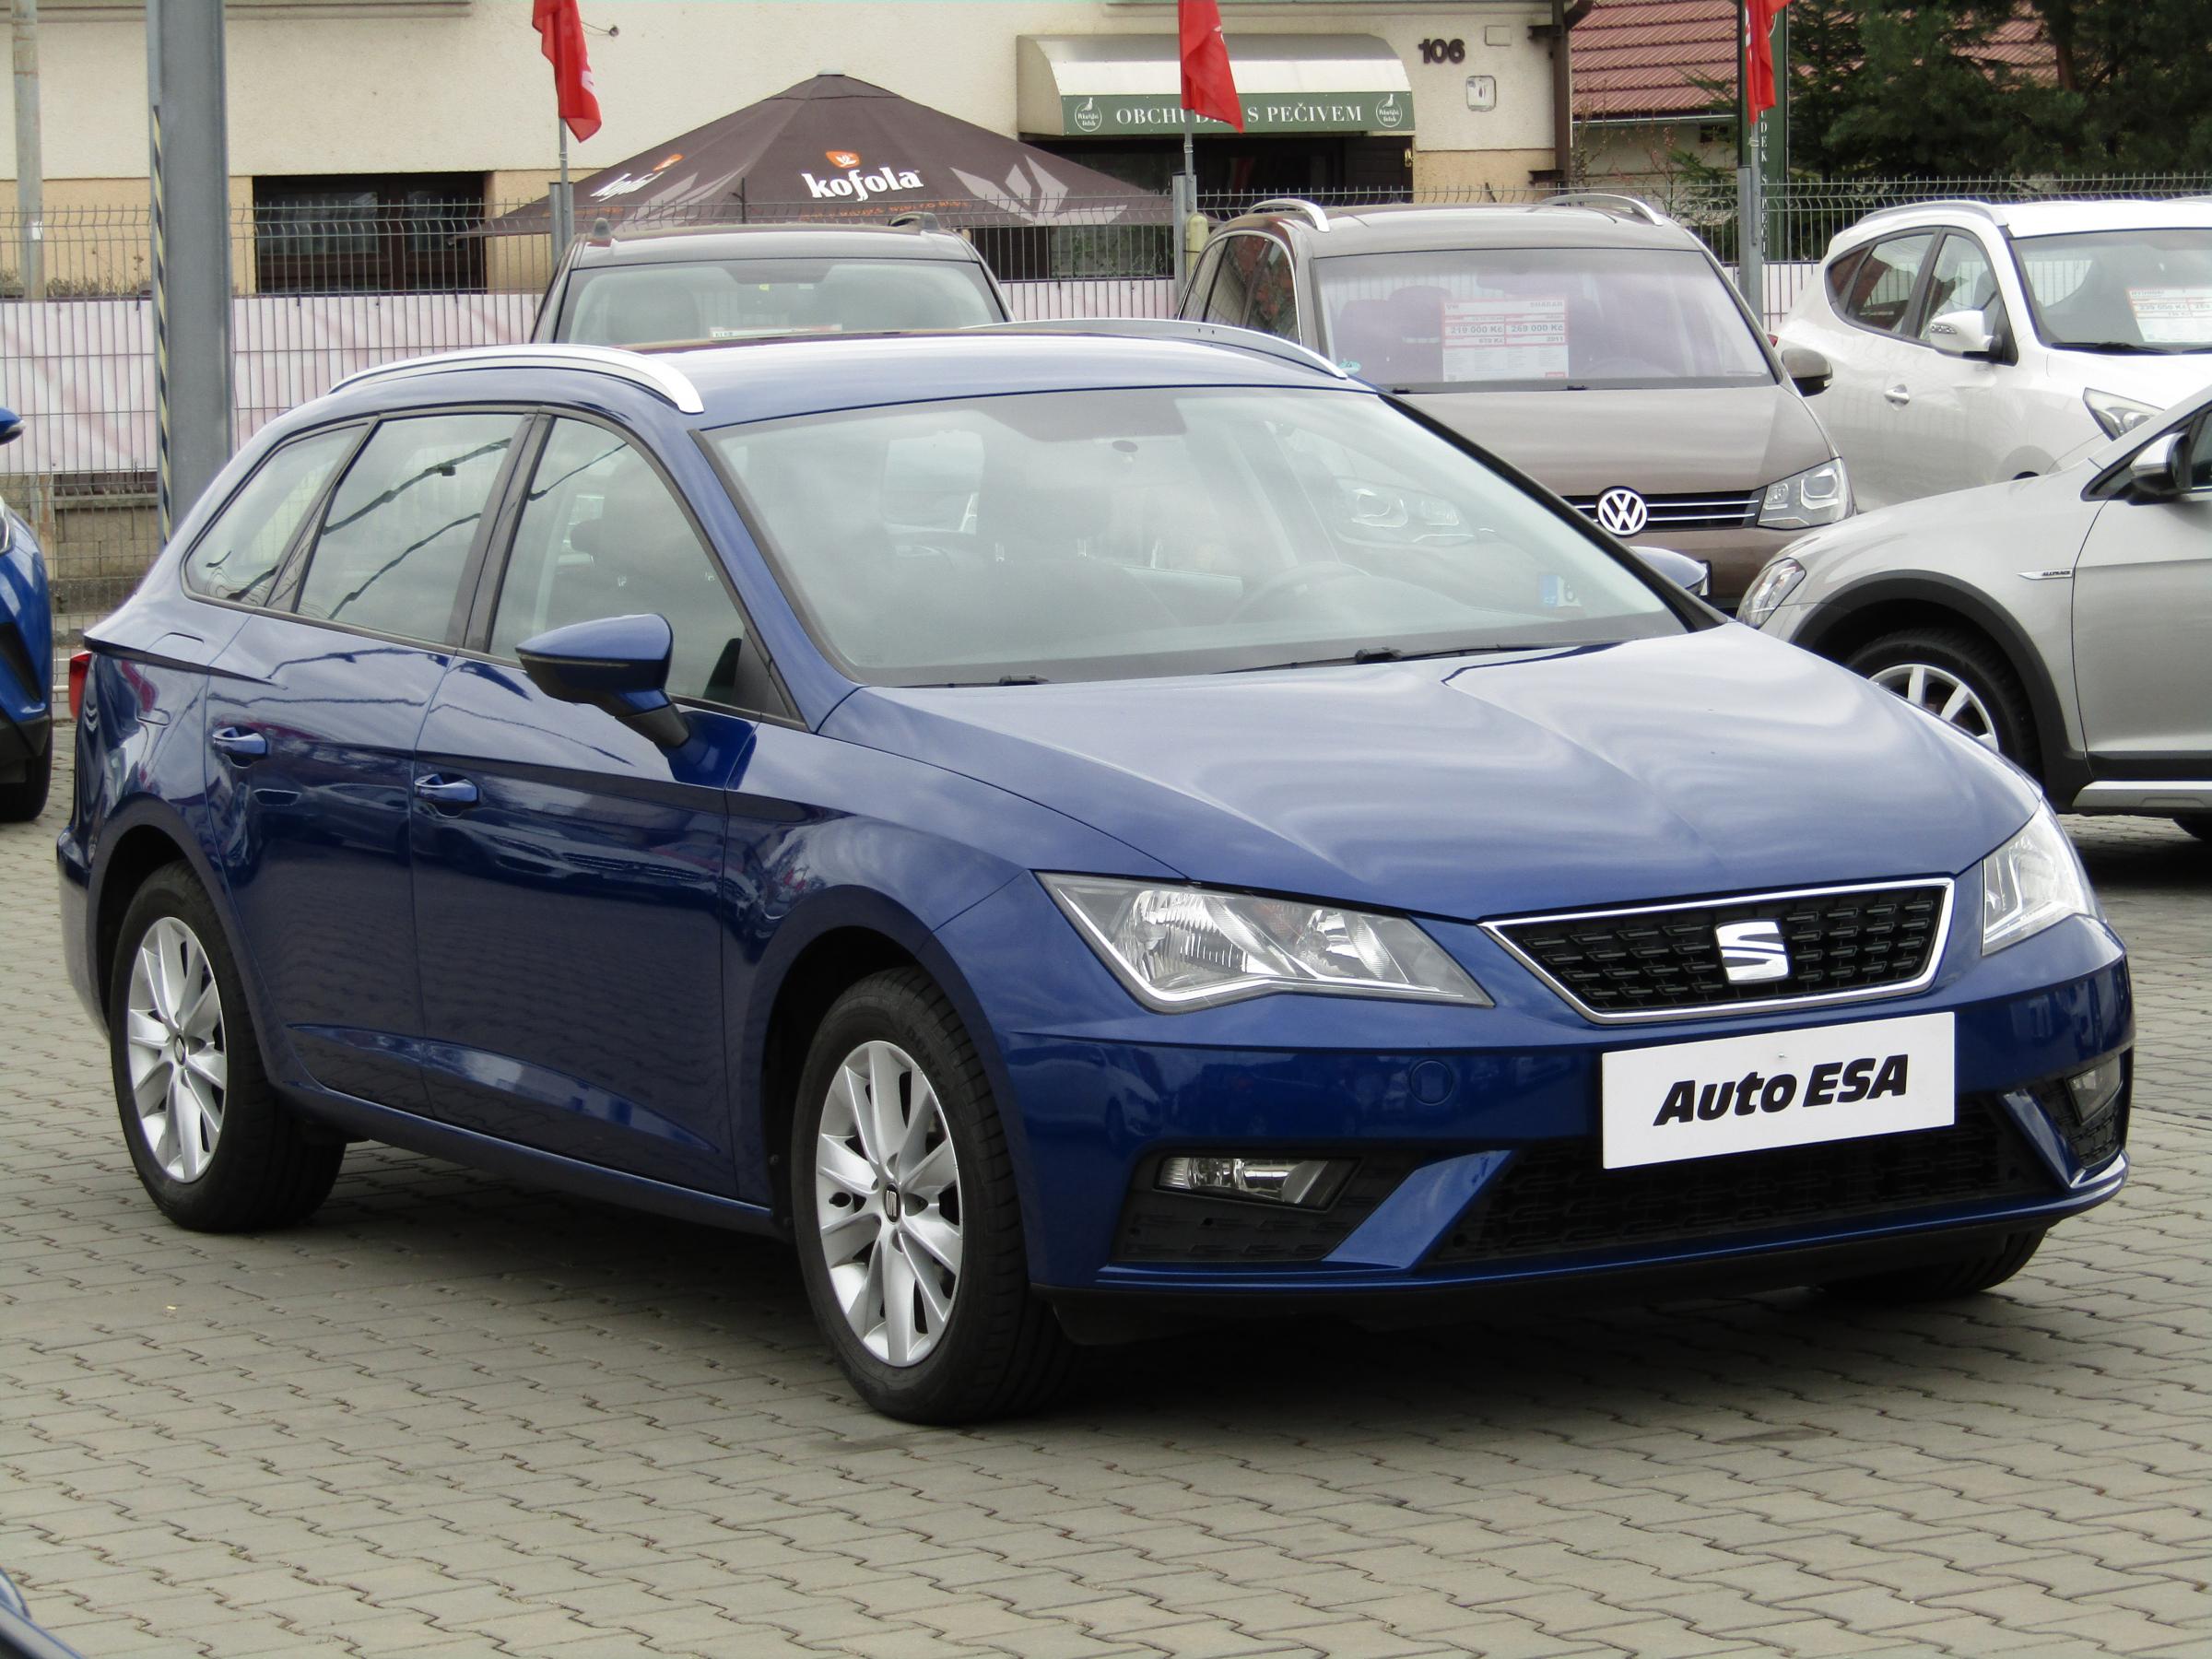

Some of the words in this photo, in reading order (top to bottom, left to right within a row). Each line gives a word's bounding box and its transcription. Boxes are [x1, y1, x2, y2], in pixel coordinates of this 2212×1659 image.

[1418, 38, 1465, 65] 106
[1247, 106, 1259, 123] S
[1267, 101, 1364, 123] PEČIVEM
[801, 167, 924, 202] kofola
[1470, 324, 1488, 334] 000
[1490, 324, 1503, 333] Kč
[1531, 324, 1548, 332] 000
[1550, 324, 1564, 332] Kč
[1652, 1071, 1798, 1127] Auto
[1802, 1053, 1910, 1108] ESA
